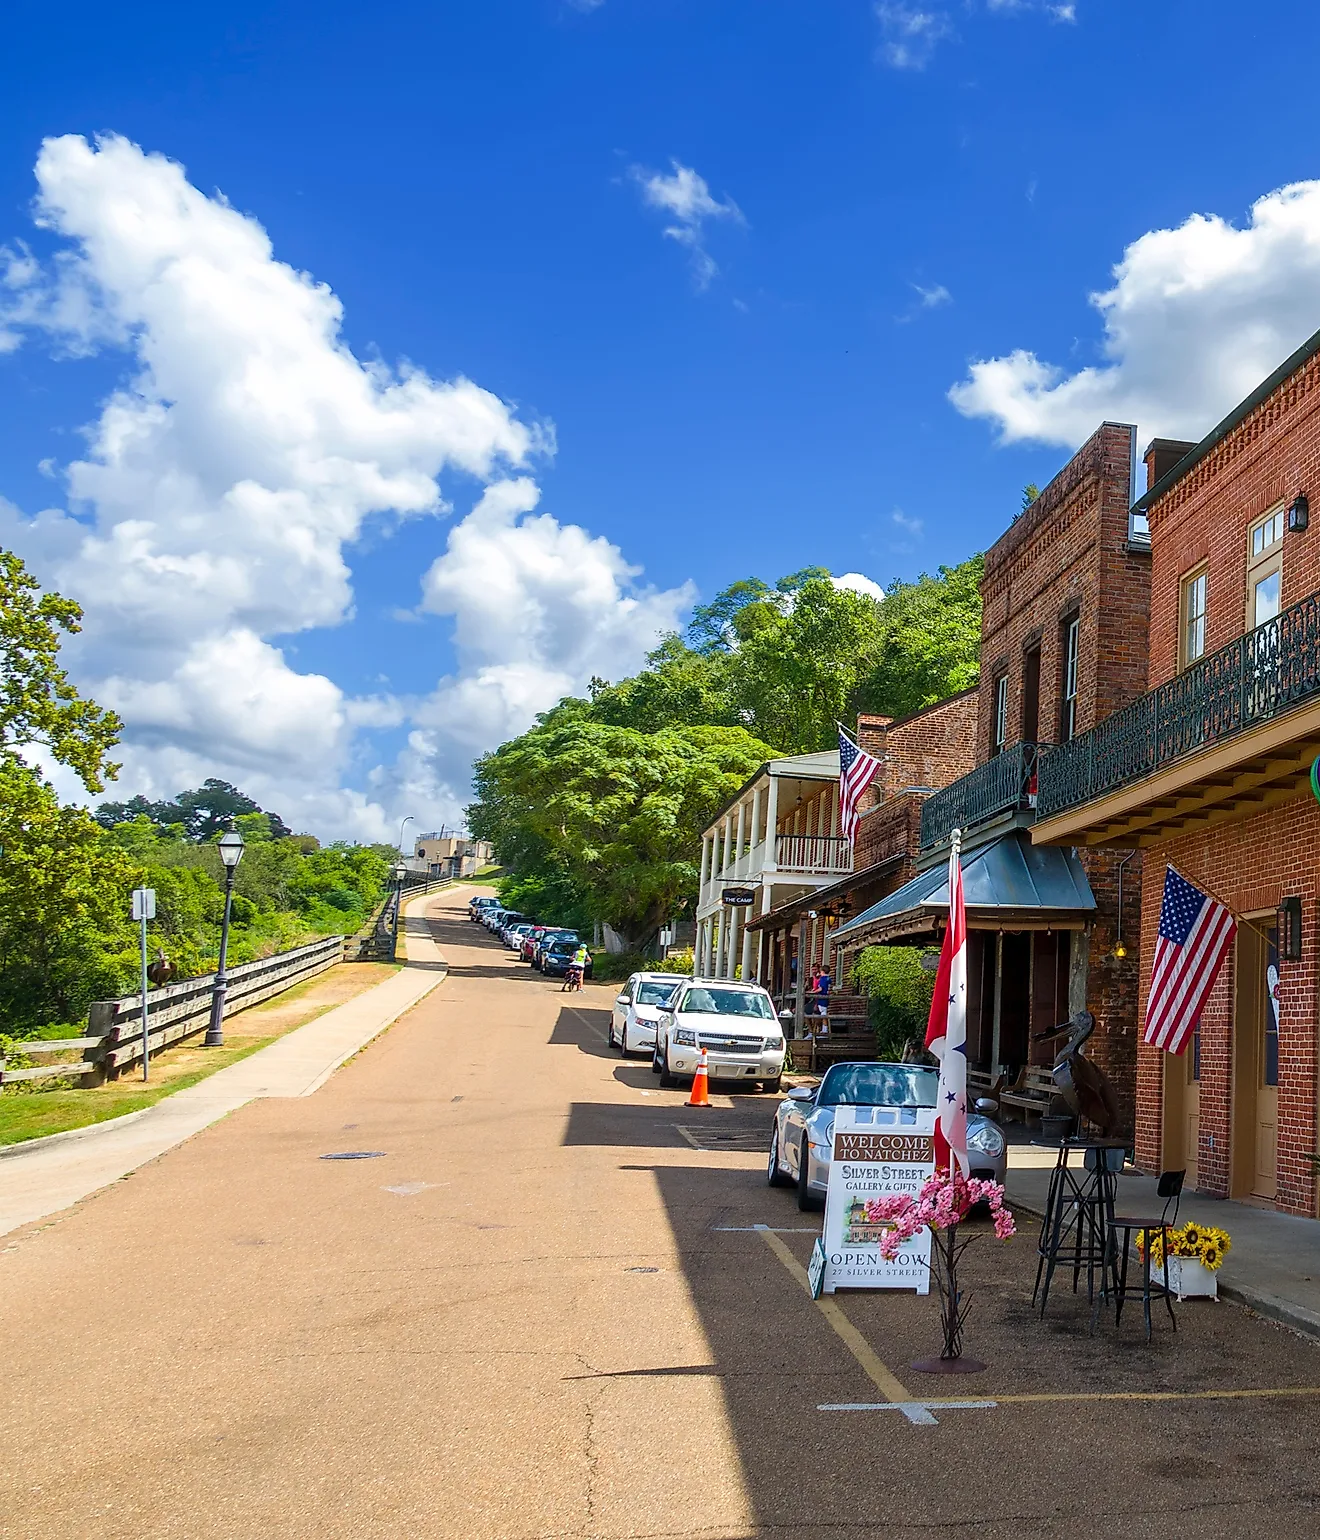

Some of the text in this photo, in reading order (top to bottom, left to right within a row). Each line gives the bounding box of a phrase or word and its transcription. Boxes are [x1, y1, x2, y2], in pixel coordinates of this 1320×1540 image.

[841, 1135, 930, 1150] WELCOME
[840, 1148, 930, 1161] TO NATCHEZ
[842, 1165, 925, 1180] SILVER STREET
[845, 1182, 917, 1191] GALLERY & GIFTS
[830, 1253, 878, 1266] OPEN
